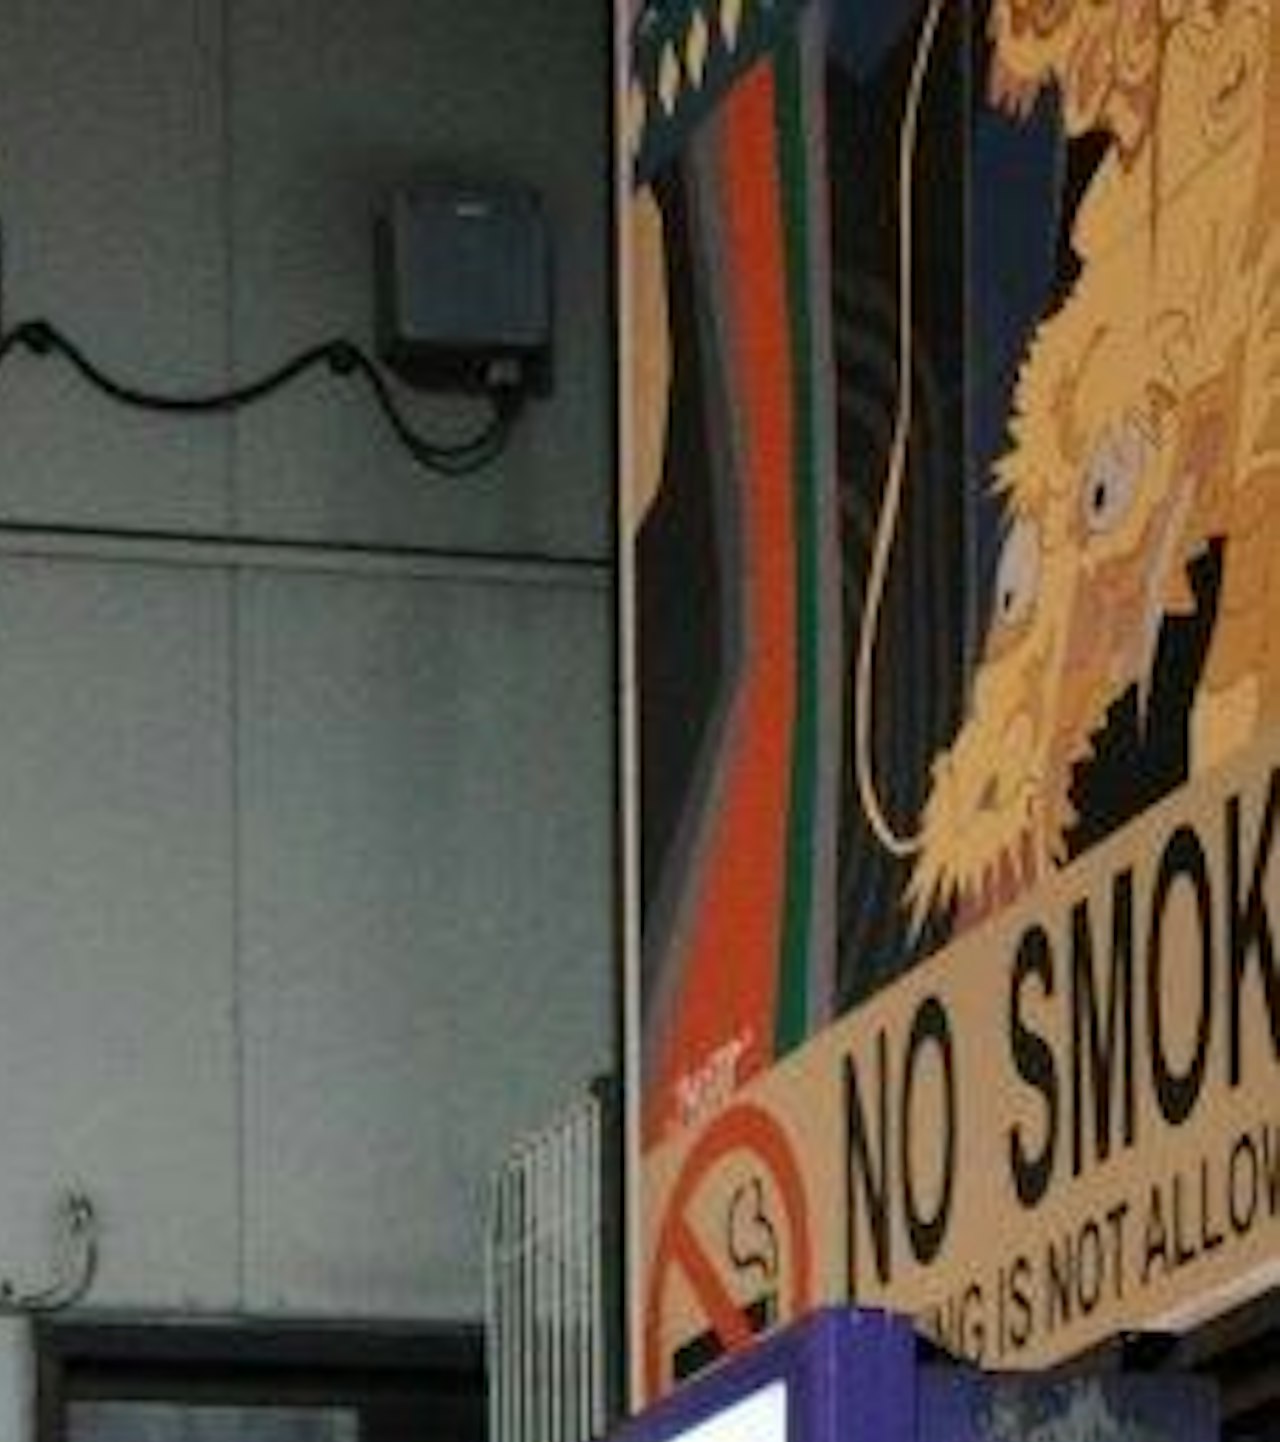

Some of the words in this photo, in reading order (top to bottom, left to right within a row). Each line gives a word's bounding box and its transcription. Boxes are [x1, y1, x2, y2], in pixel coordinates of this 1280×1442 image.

[844, 996, 958, 1302] NO
[995, 1255, 1033, 1358] IS
[1047, 1202, 1130, 1332] NOT
